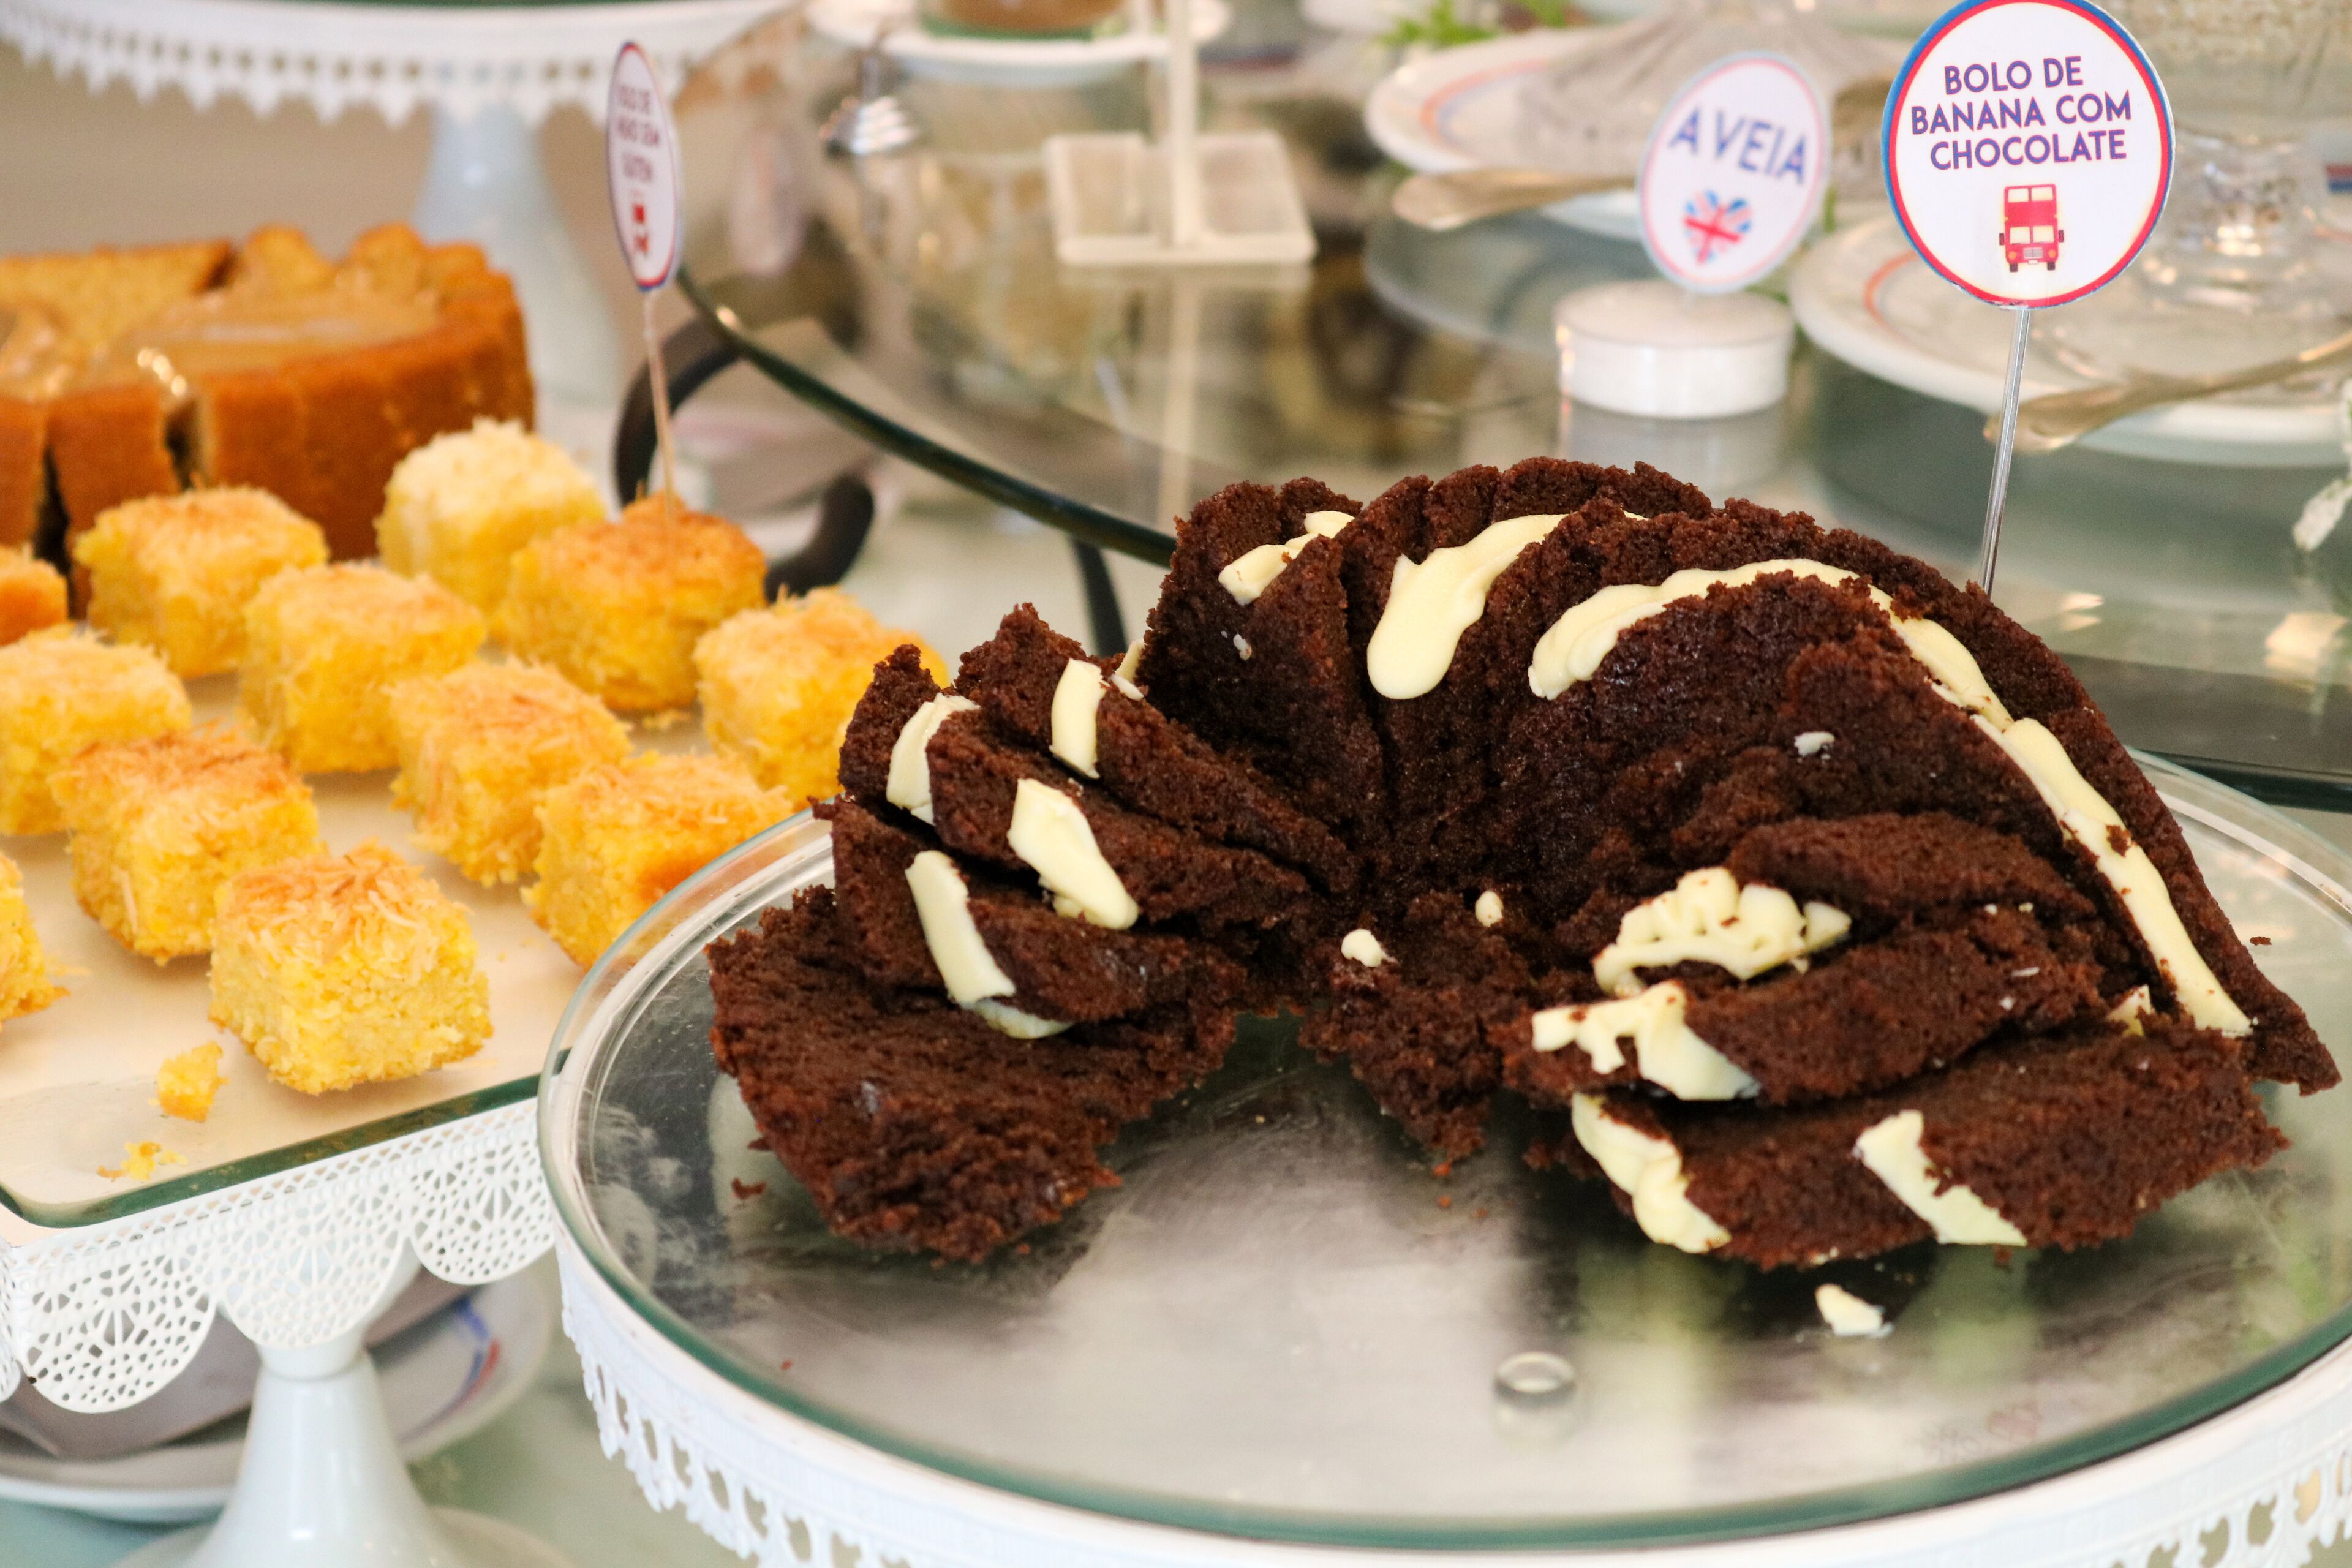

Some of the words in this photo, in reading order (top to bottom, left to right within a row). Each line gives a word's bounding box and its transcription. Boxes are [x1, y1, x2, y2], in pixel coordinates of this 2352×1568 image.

[1944, 60, 2032, 95] BOLO
[2043, 56, 2083, 88] DE
[1911, 96, 2046, 135] BANANA
[2056, 90, 2132, 124] COM
[1668, 106, 1806, 186] AVEIA
[1930, 129, 2127, 170] CHOCOLATE
